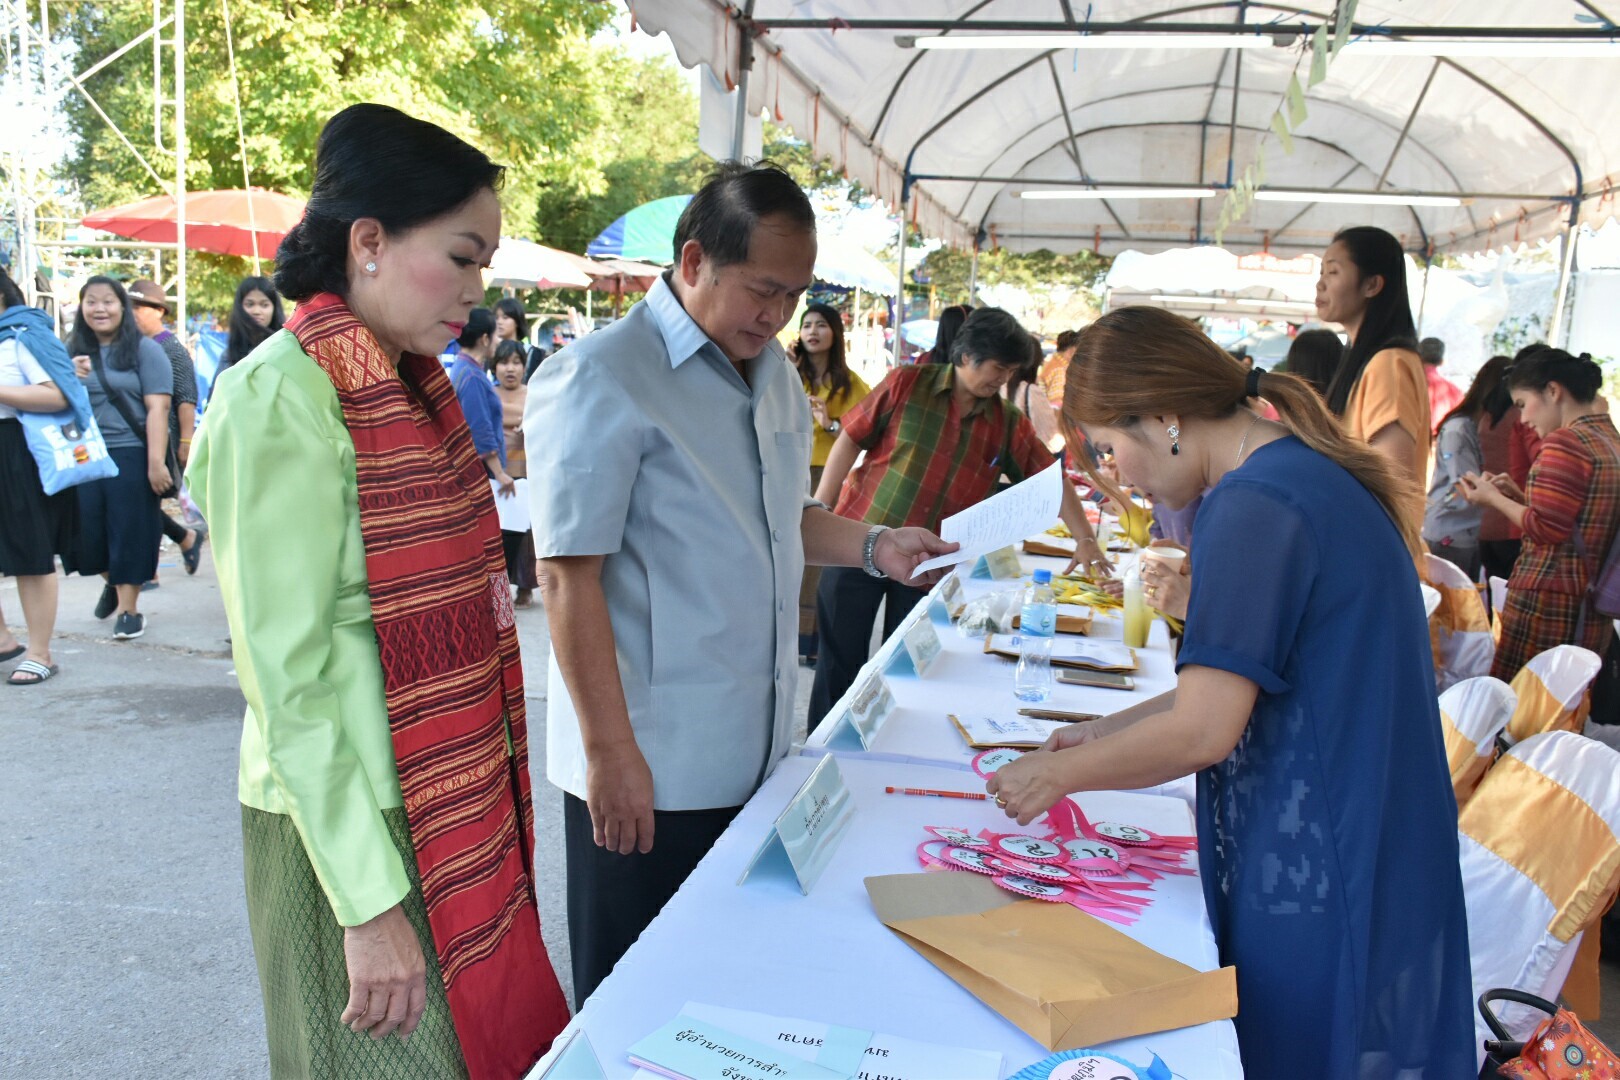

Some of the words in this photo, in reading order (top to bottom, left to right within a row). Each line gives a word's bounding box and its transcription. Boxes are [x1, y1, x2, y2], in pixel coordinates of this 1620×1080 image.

[675, 1029, 788, 1078] ผู้อำนวยการสำ
